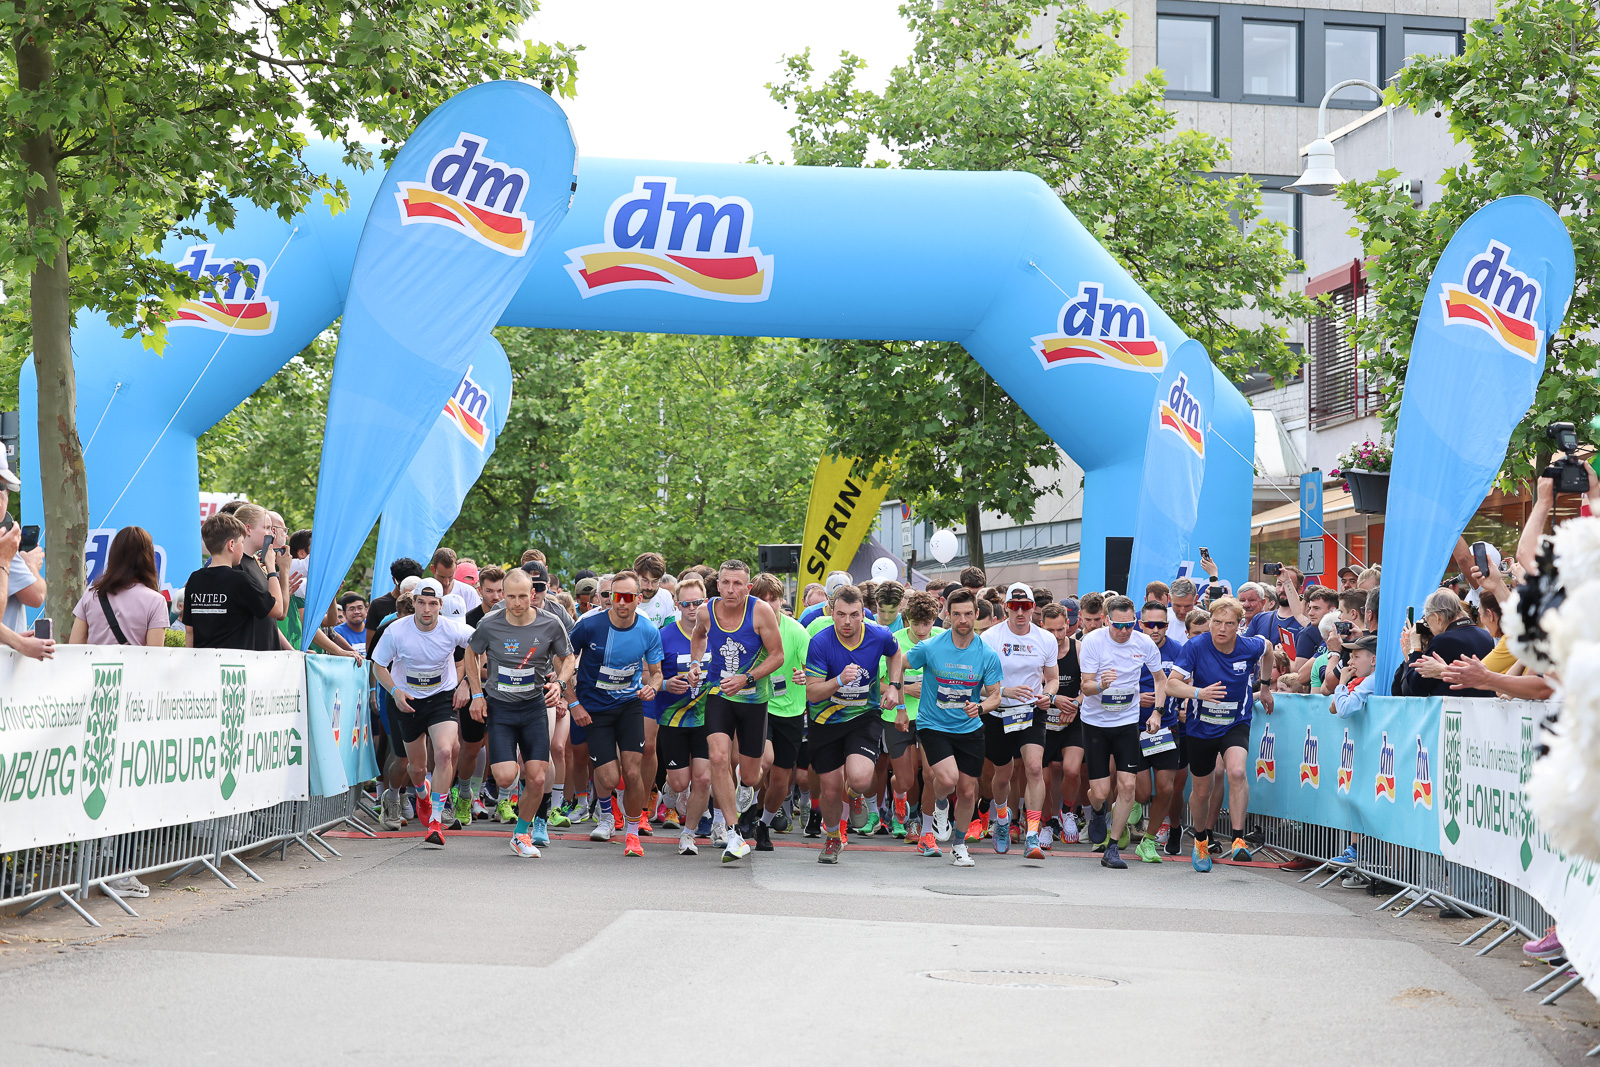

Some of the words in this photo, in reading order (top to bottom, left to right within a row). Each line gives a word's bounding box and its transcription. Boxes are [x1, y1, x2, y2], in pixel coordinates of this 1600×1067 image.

[431, 139, 524, 214] dm
[613, 182, 745, 253] dm
[1467, 246, 1537, 321] dm
[1063, 287, 1145, 338] dm
[1169, 376, 1200, 430] dm
[1305, 481, 1318, 530] P
[119, 735, 217, 789] HOMBURG
[1260, 726, 1275, 760] dm
[1304, 728, 1318, 764] dm
[1341, 731, 1354, 769] dm
[1380, 735, 1394, 776] dm
[1416, 738, 1430, 781] dm
